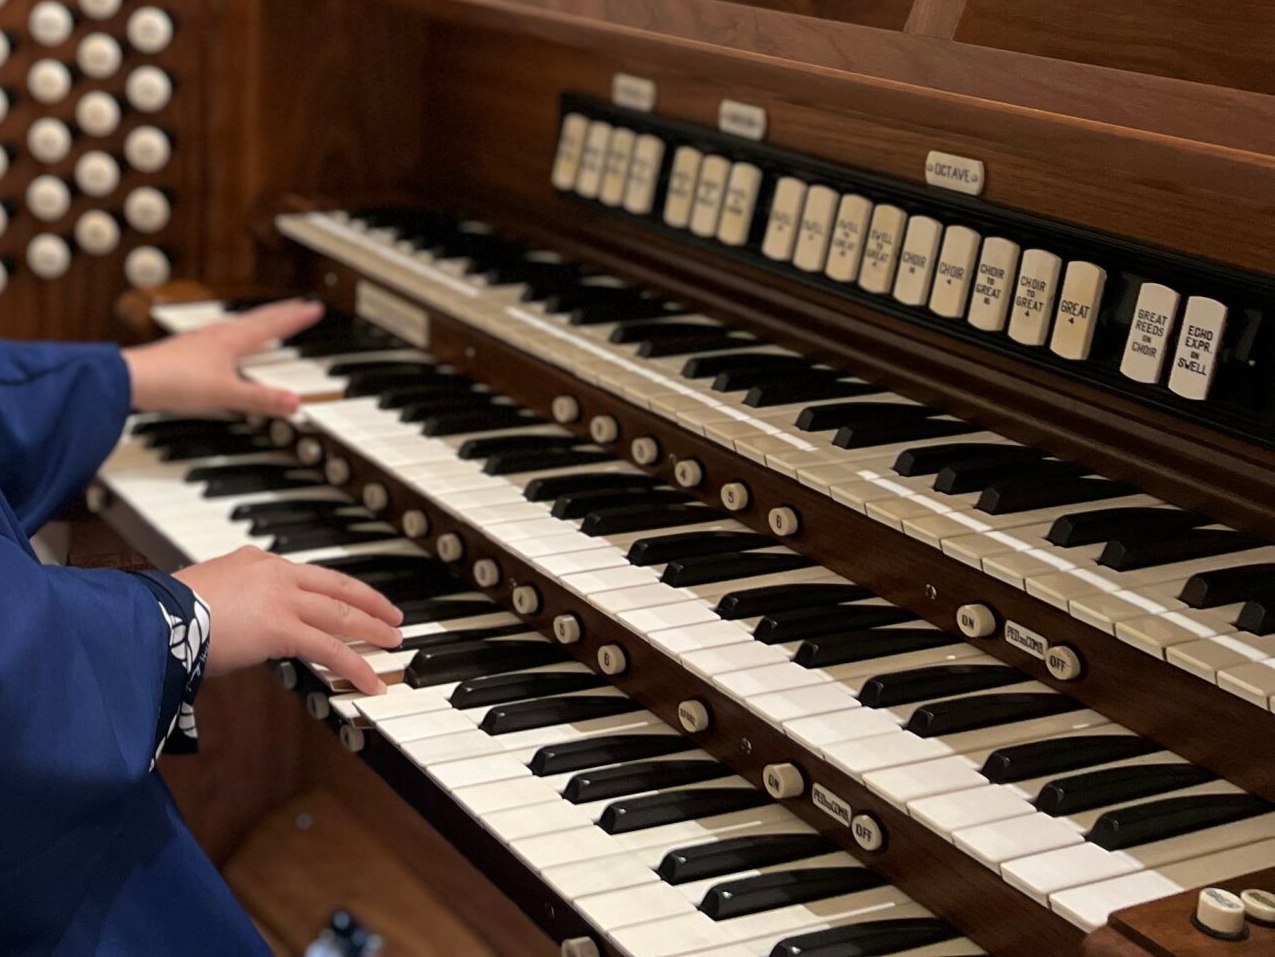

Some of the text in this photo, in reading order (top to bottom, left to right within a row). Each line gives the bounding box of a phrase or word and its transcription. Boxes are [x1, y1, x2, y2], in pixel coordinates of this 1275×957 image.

[934, 163, 971, 183] OCTAVE
[870, 229, 892, 244] SWELL
[867, 248, 889, 262] GREAT
[903, 251, 926, 268] CHOIR
[939, 262, 965, 280] CHOIR
[980, 264, 1005, 279] CHOIR
[987, 277, 995, 285] TO
[1020, 276, 1046, 292] CHOIR
[976, 284, 1002, 298] GREAT
[1026, 289, 1036, 298] TO
[1016, 296, 1044, 312] GREAT
[1060, 300, 1091, 319] GREAT
[1138, 309, 1167, 326] GREAT
[1135, 320, 1164, 337] REEDS
[1188, 325, 1213, 341] ECHO
[1131, 341, 1157, 358] CHOIR
[1190, 351, 1200, 360] ON
[1177, 357, 1207, 377] SWELL
[728, 491, 735, 504] 5
[961, 614, 974, 630] ON
[1049, 655, 1067, 672] OFF
[768, 773, 779, 793] ON
[855, 823, 873, 843] OFF
